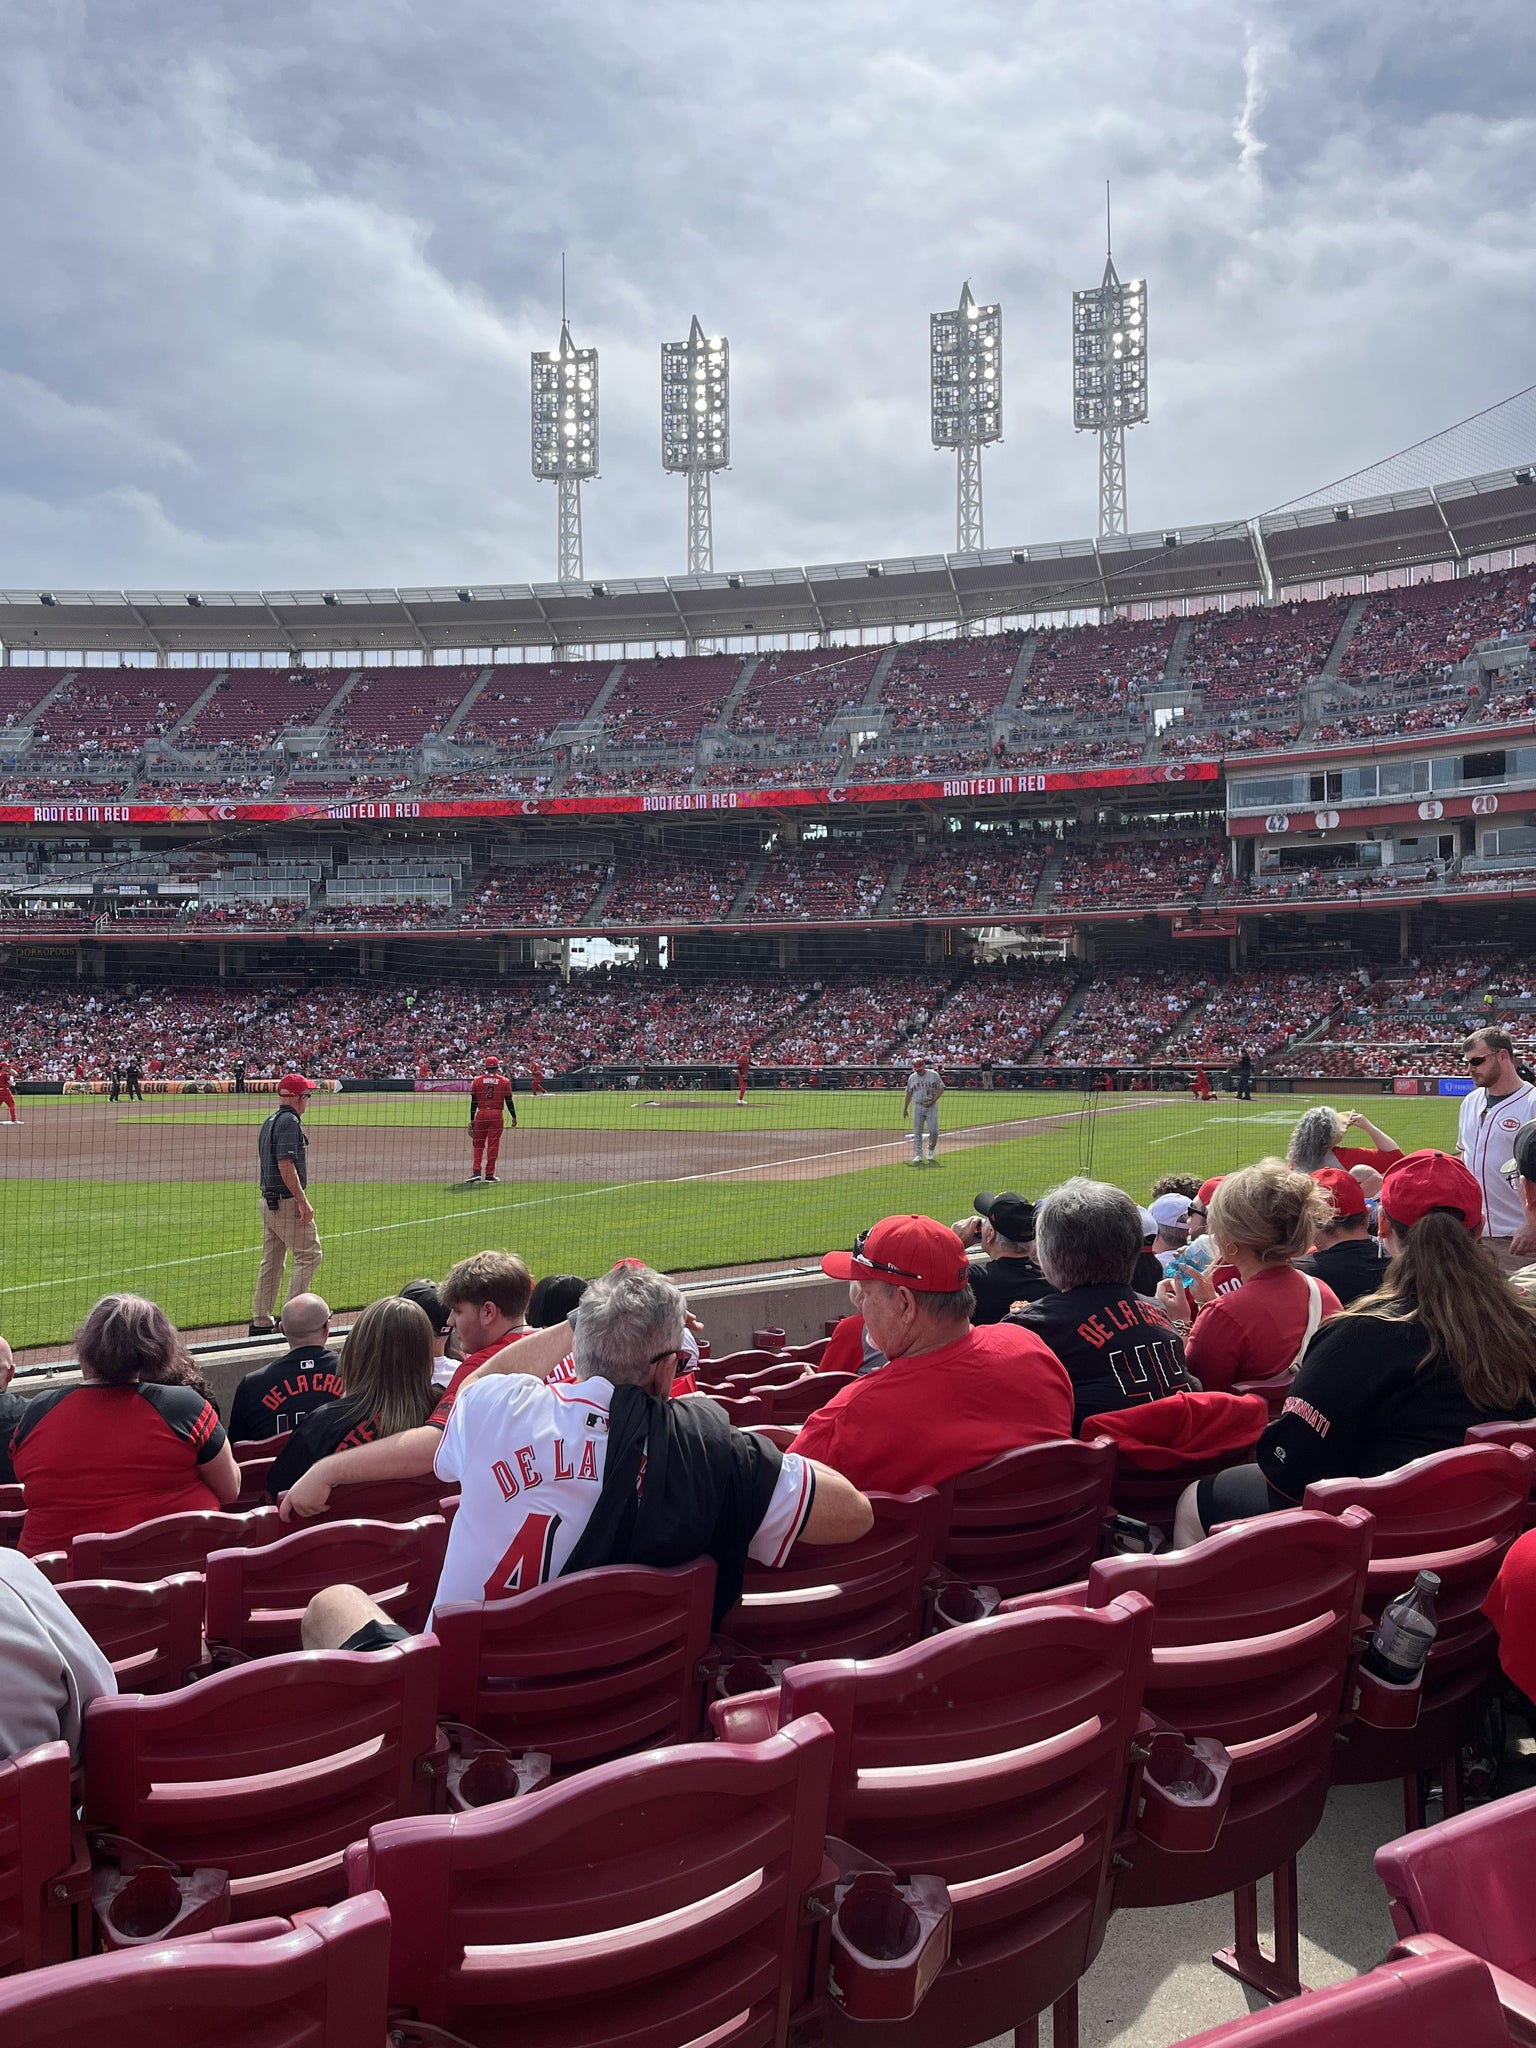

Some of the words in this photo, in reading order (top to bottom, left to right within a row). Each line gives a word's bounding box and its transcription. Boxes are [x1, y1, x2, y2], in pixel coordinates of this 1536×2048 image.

[943, 780, 996, 797] ROOTED
[1000, 777, 1013, 793] IN
[1018, 775, 1046, 792] RED
[643, 795, 691, 811] ROOTED
[695, 794, 707, 809] IN
[712, 792, 737, 809] RED
[1475, 796, 1496, 813] 20
[34, 806, 83, 822] ROOTED
[87, 806, 99, 821] IN
[104, 806, 130, 821] RED
[328, 804, 375, 819] ROOTED
[379, 803, 391, 818] IN
[395, 803, 420, 818] RED
[1426, 802, 1436, 818] 5
[1268, 816, 1286, 832] 42
[1323, 812, 1331, 828] 1
[144, 1082, 169, 1093] GLUE
[227, 1081, 270, 1093] GRILLA
[486, 1085, 494, 1099] 3
[1077, 1313, 1115, 1348] DE
[1104, 1299, 1140, 1331] LA
[261, 1385, 288, 1411] DE
[283, 1374, 309, 1396] LA
[312, 1373, 344, 1398] CRU
[491, 1444, 543, 1502] DE
[554, 1438, 599, 1481] LA
